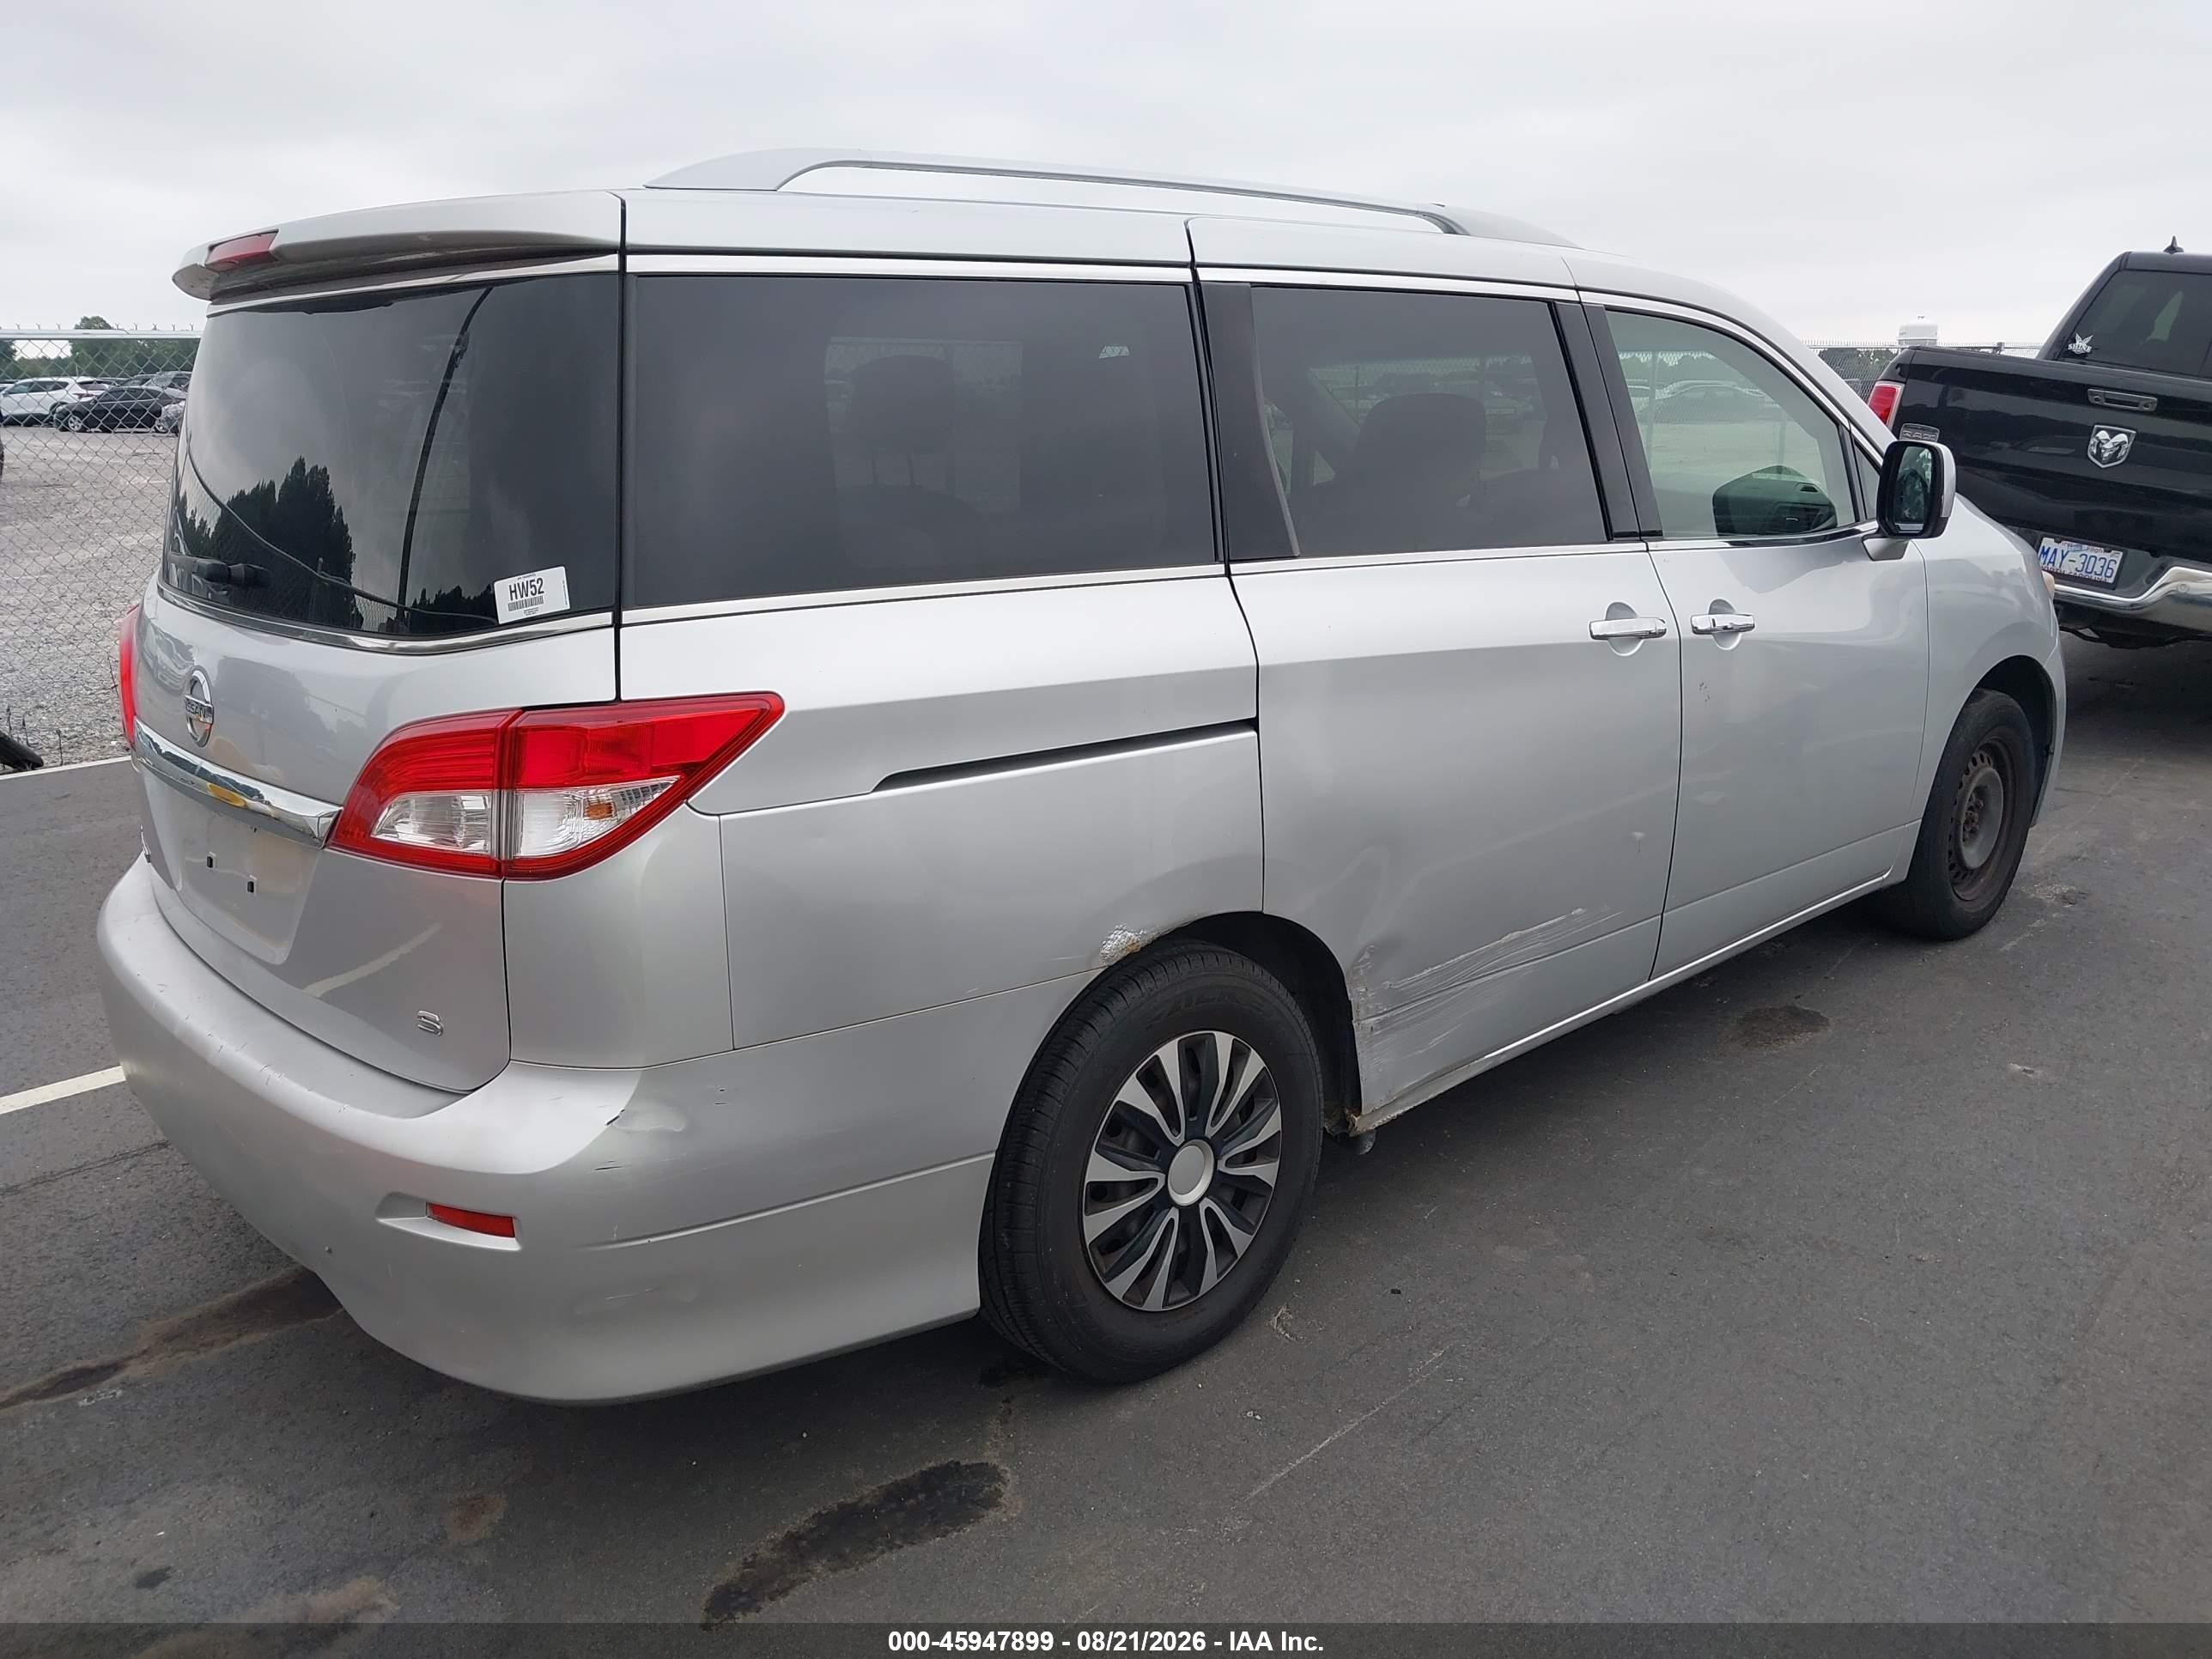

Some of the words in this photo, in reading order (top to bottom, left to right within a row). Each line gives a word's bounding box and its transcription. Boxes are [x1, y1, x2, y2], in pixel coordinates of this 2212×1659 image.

[2068, 343, 2093, 353] SHINE
[2039, 545, 2118, 579] MAY-3036
[508, 577, 545, 601] HW52
[417, 1010, 444, 1037] S
